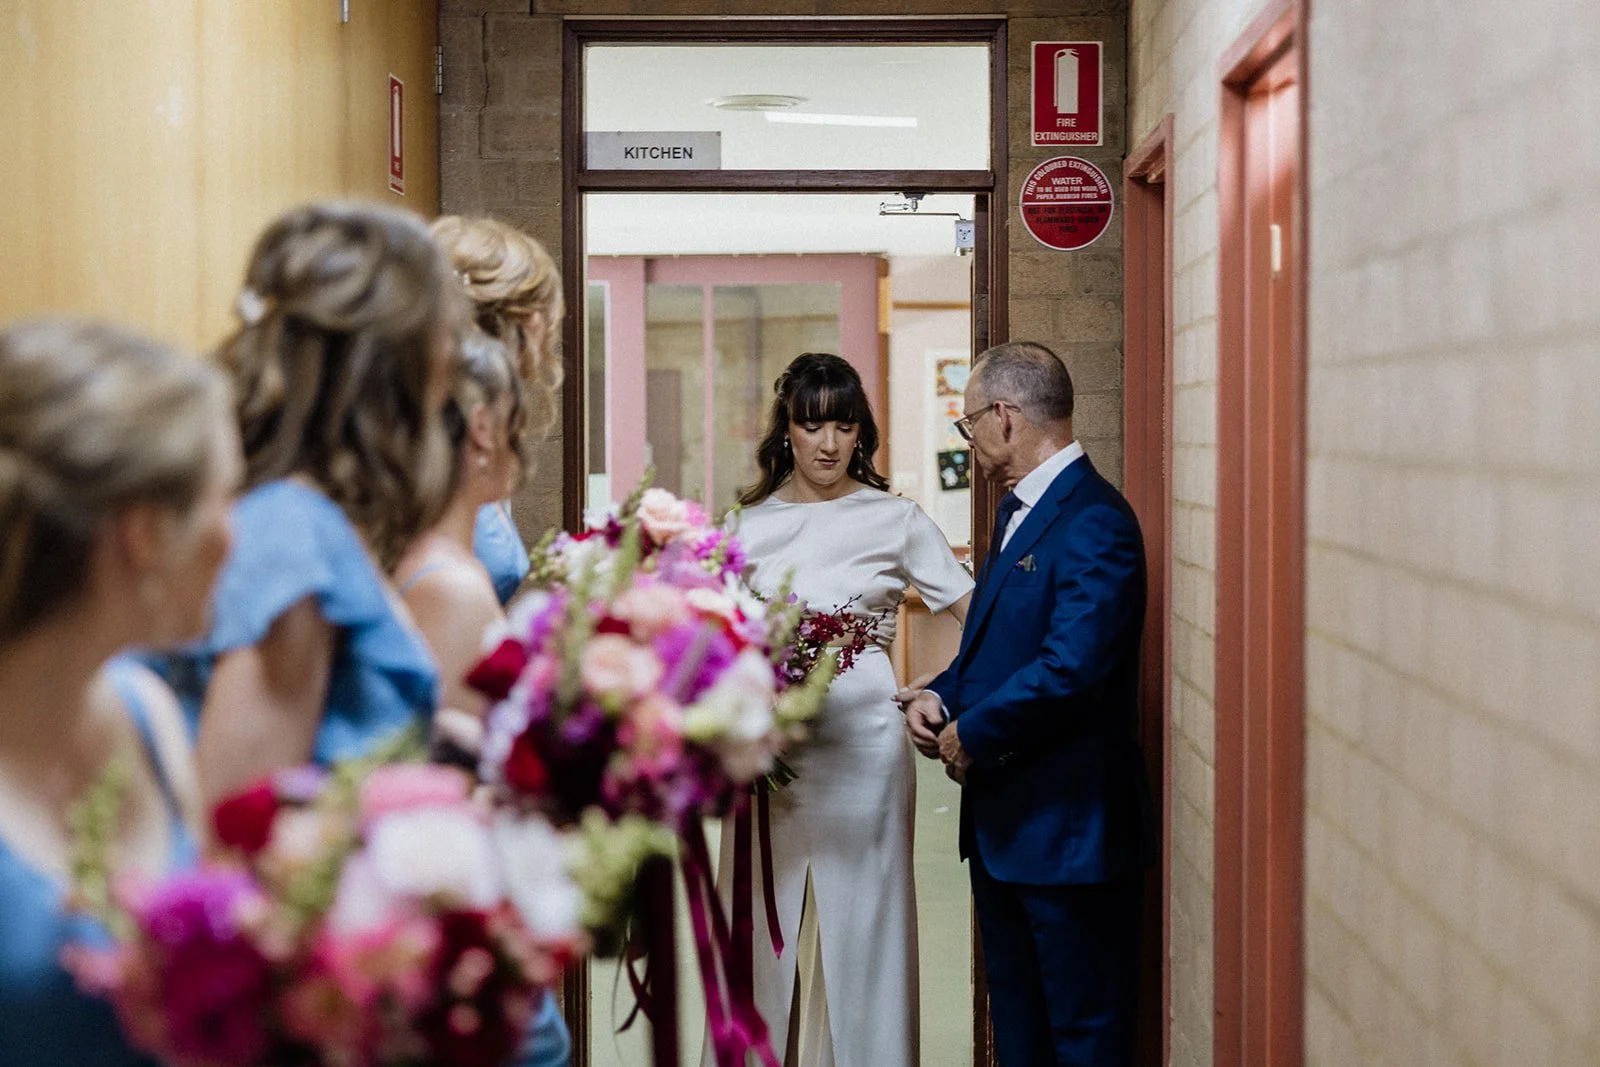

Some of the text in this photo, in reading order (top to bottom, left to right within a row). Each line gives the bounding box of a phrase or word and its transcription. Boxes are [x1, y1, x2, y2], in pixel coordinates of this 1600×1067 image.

[1056, 118, 1077, 127] FIRE
[1035, 132, 1098, 141] EXTINGUISHER
[624, 147, 693, 159] KITCHEN
[1025, 161, 1108, 195] THIS COLOURED EXTINGUISHER
[1051, 177, 1083, 185] WATER
